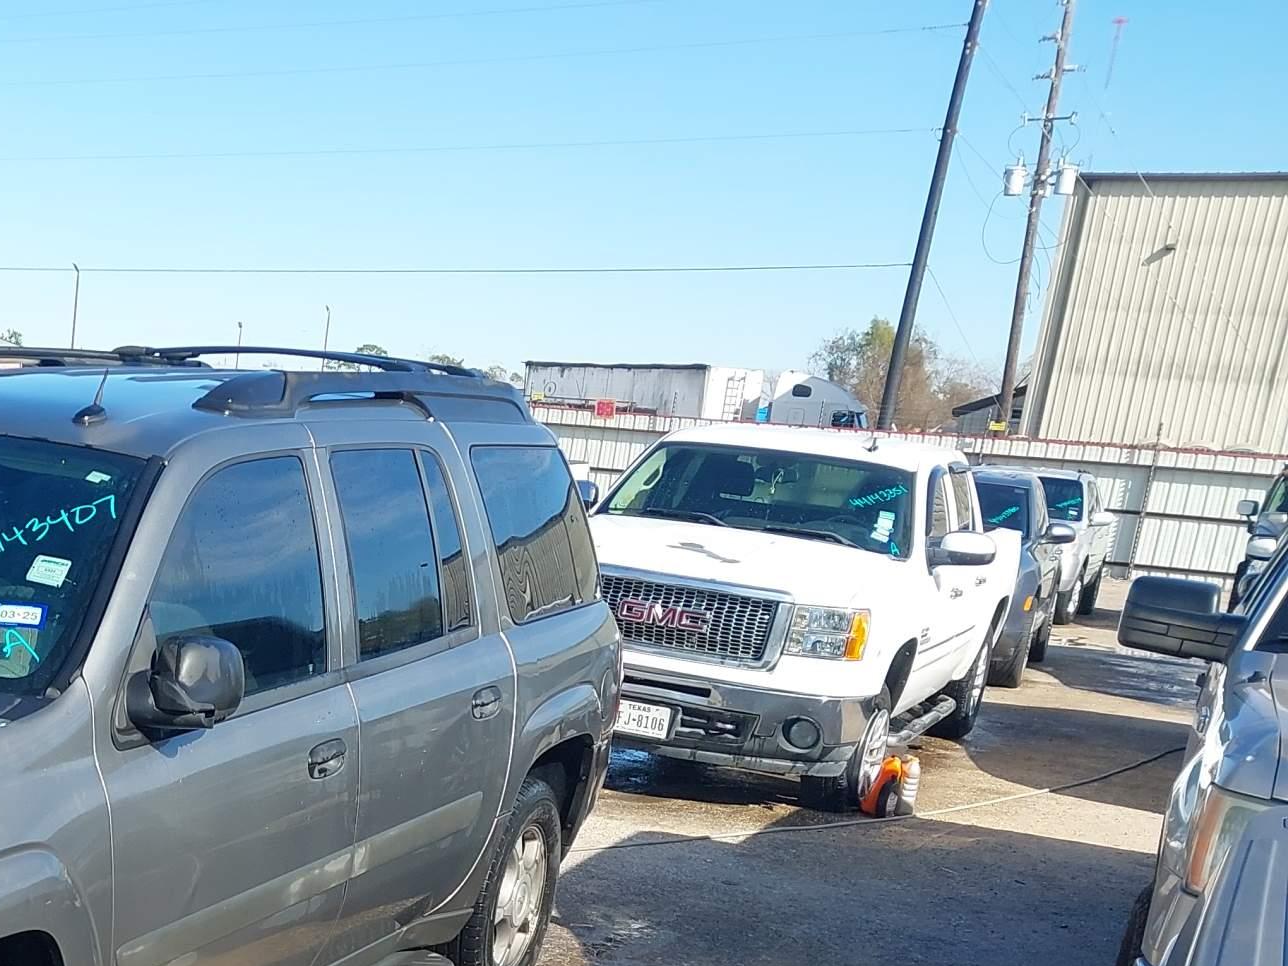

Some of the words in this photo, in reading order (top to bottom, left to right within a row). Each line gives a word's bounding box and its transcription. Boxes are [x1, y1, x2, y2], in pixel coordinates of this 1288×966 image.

[618, 599, 708, 632] GMC
[628, 703, 652, 713] TEXAS
[616, 711, 665, 731] FJ-8106
